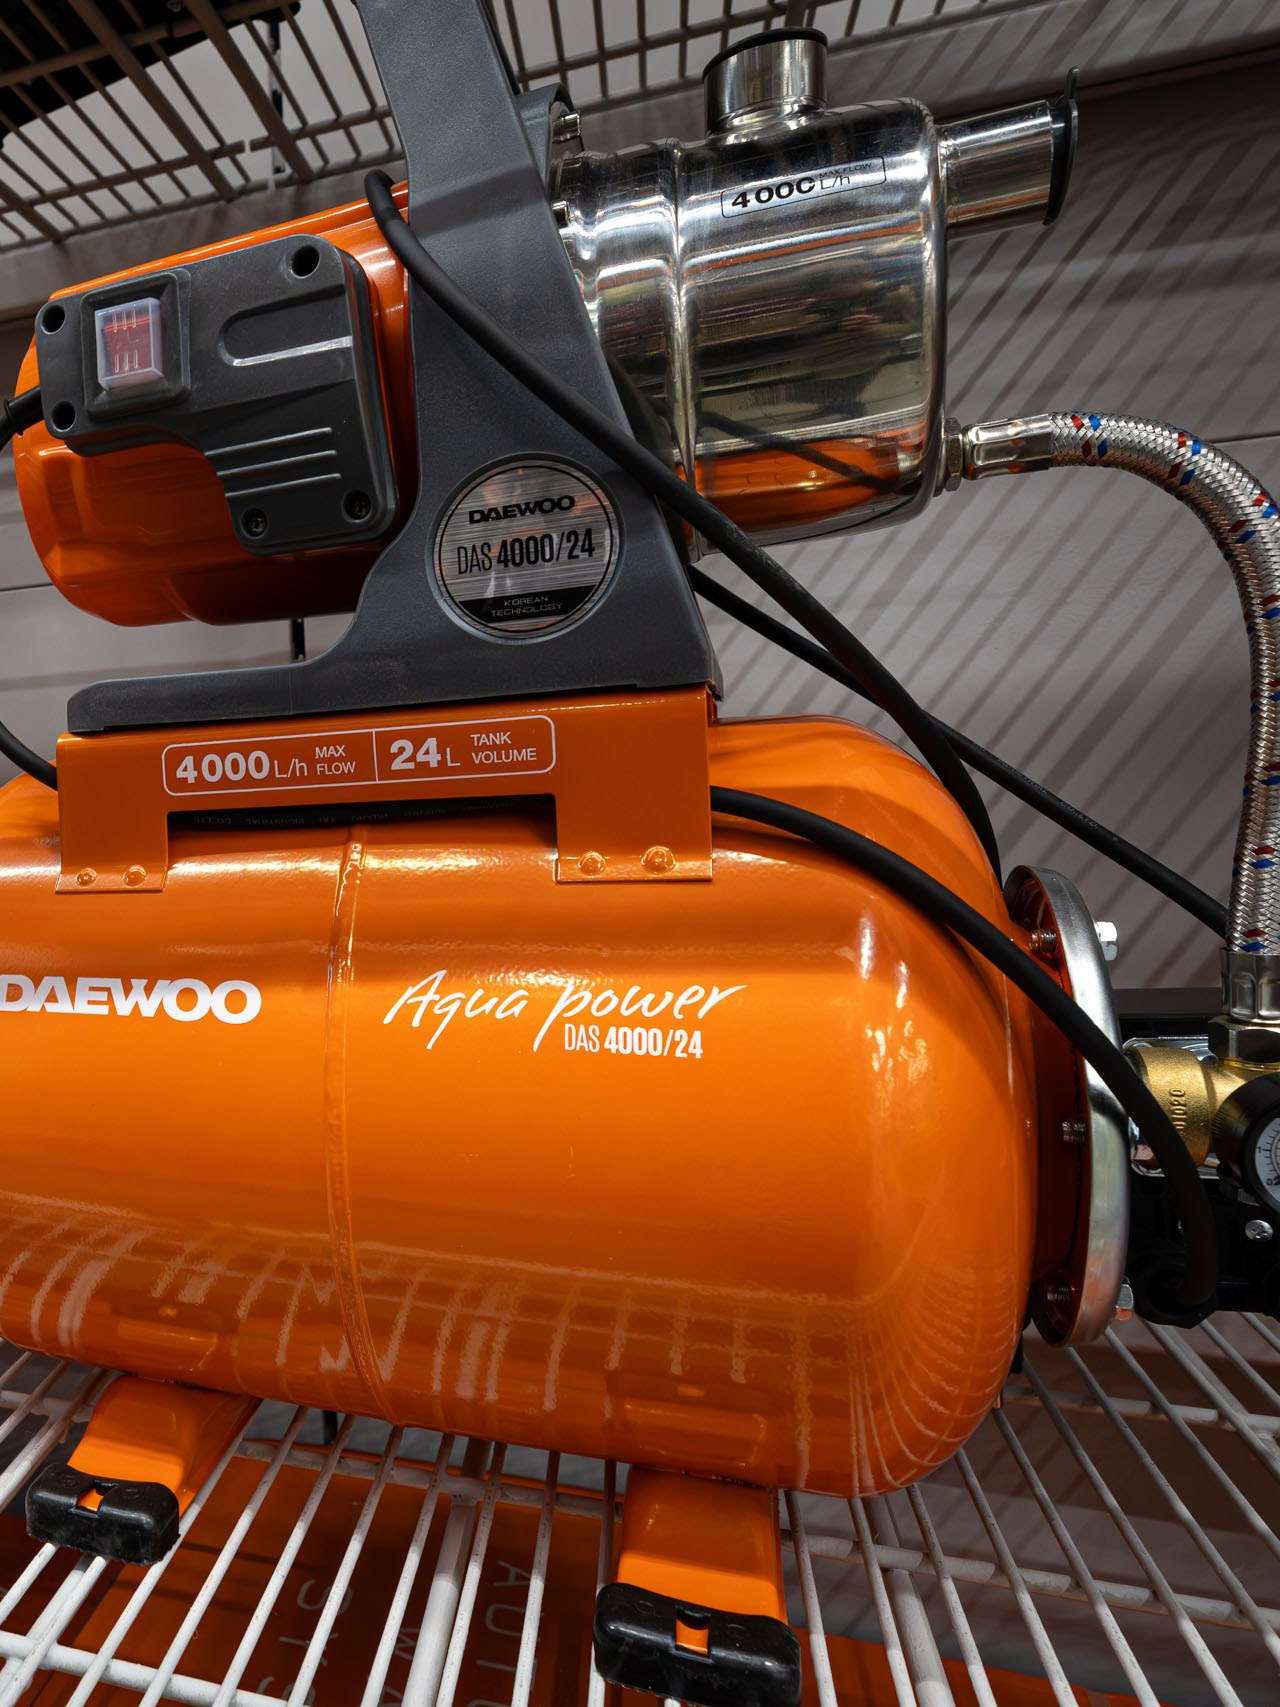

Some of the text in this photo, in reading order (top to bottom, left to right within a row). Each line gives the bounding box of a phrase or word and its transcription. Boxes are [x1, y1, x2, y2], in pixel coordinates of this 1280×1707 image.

[468, 495, 576, 525] DAEWOO
[457, 527, 596, 575] DAS 4000/24
[490, 602, 564, 618] TECHNOLOGY
[503, 594, 549, 607] KOREAN
[470, 732, 512, 747] TANK
[315, 744, 346, 759] MAX
[390, 737, 461, 771] 24 L
[471, 747, 538, 764] VOLUME
[175, 750, 308, 784] 4000 L/h
[316, 761, 356, 776] FLOW
[383, 969, 749, 1053] Aqua power
[564, 1023, 704, 1059] DAS 4000/24
